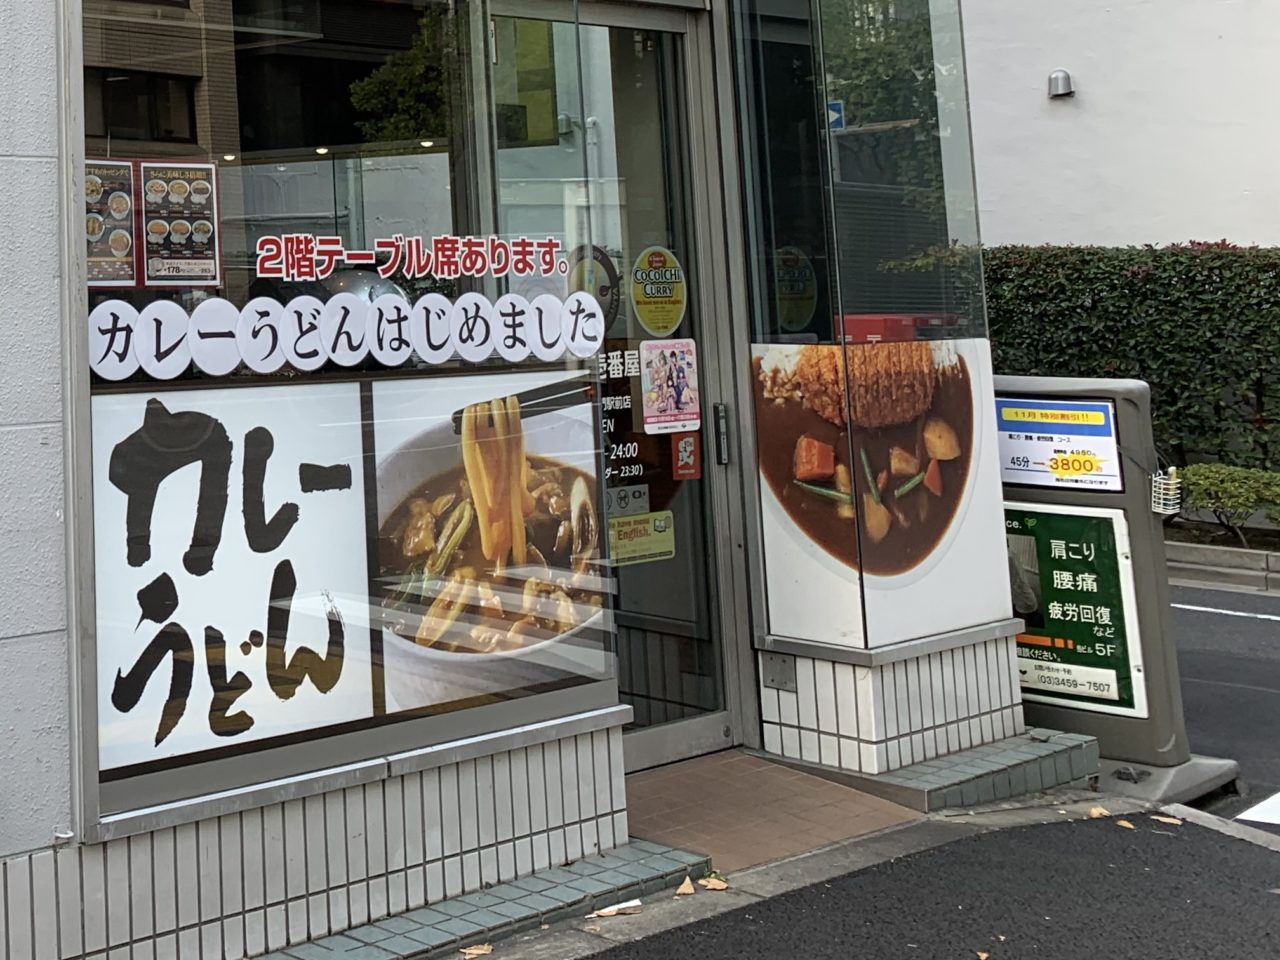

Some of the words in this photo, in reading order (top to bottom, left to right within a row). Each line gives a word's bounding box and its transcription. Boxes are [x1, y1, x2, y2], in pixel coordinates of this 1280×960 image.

[257, 233, 570, 281] 2階テーブル席あります。
[97, 298, 598, 366] カレーうどんはじめました
[610, 442, 639, 459] 24:00
[1010, 456, 1030, 468] 45分
[108, 397, 352, 577] カレー
[617, 526, 652, 542] English.
[1050, 539, 1095, 561] 肩こり
[1052, 570, 1098, 592] 腰痛
[1047, 600, 1113, 625] 疲労回復
[1092, 625, 1115, 638] など
[111, 558, 347, 748] うどん
[1094, 643, 1116, 656] 5F
